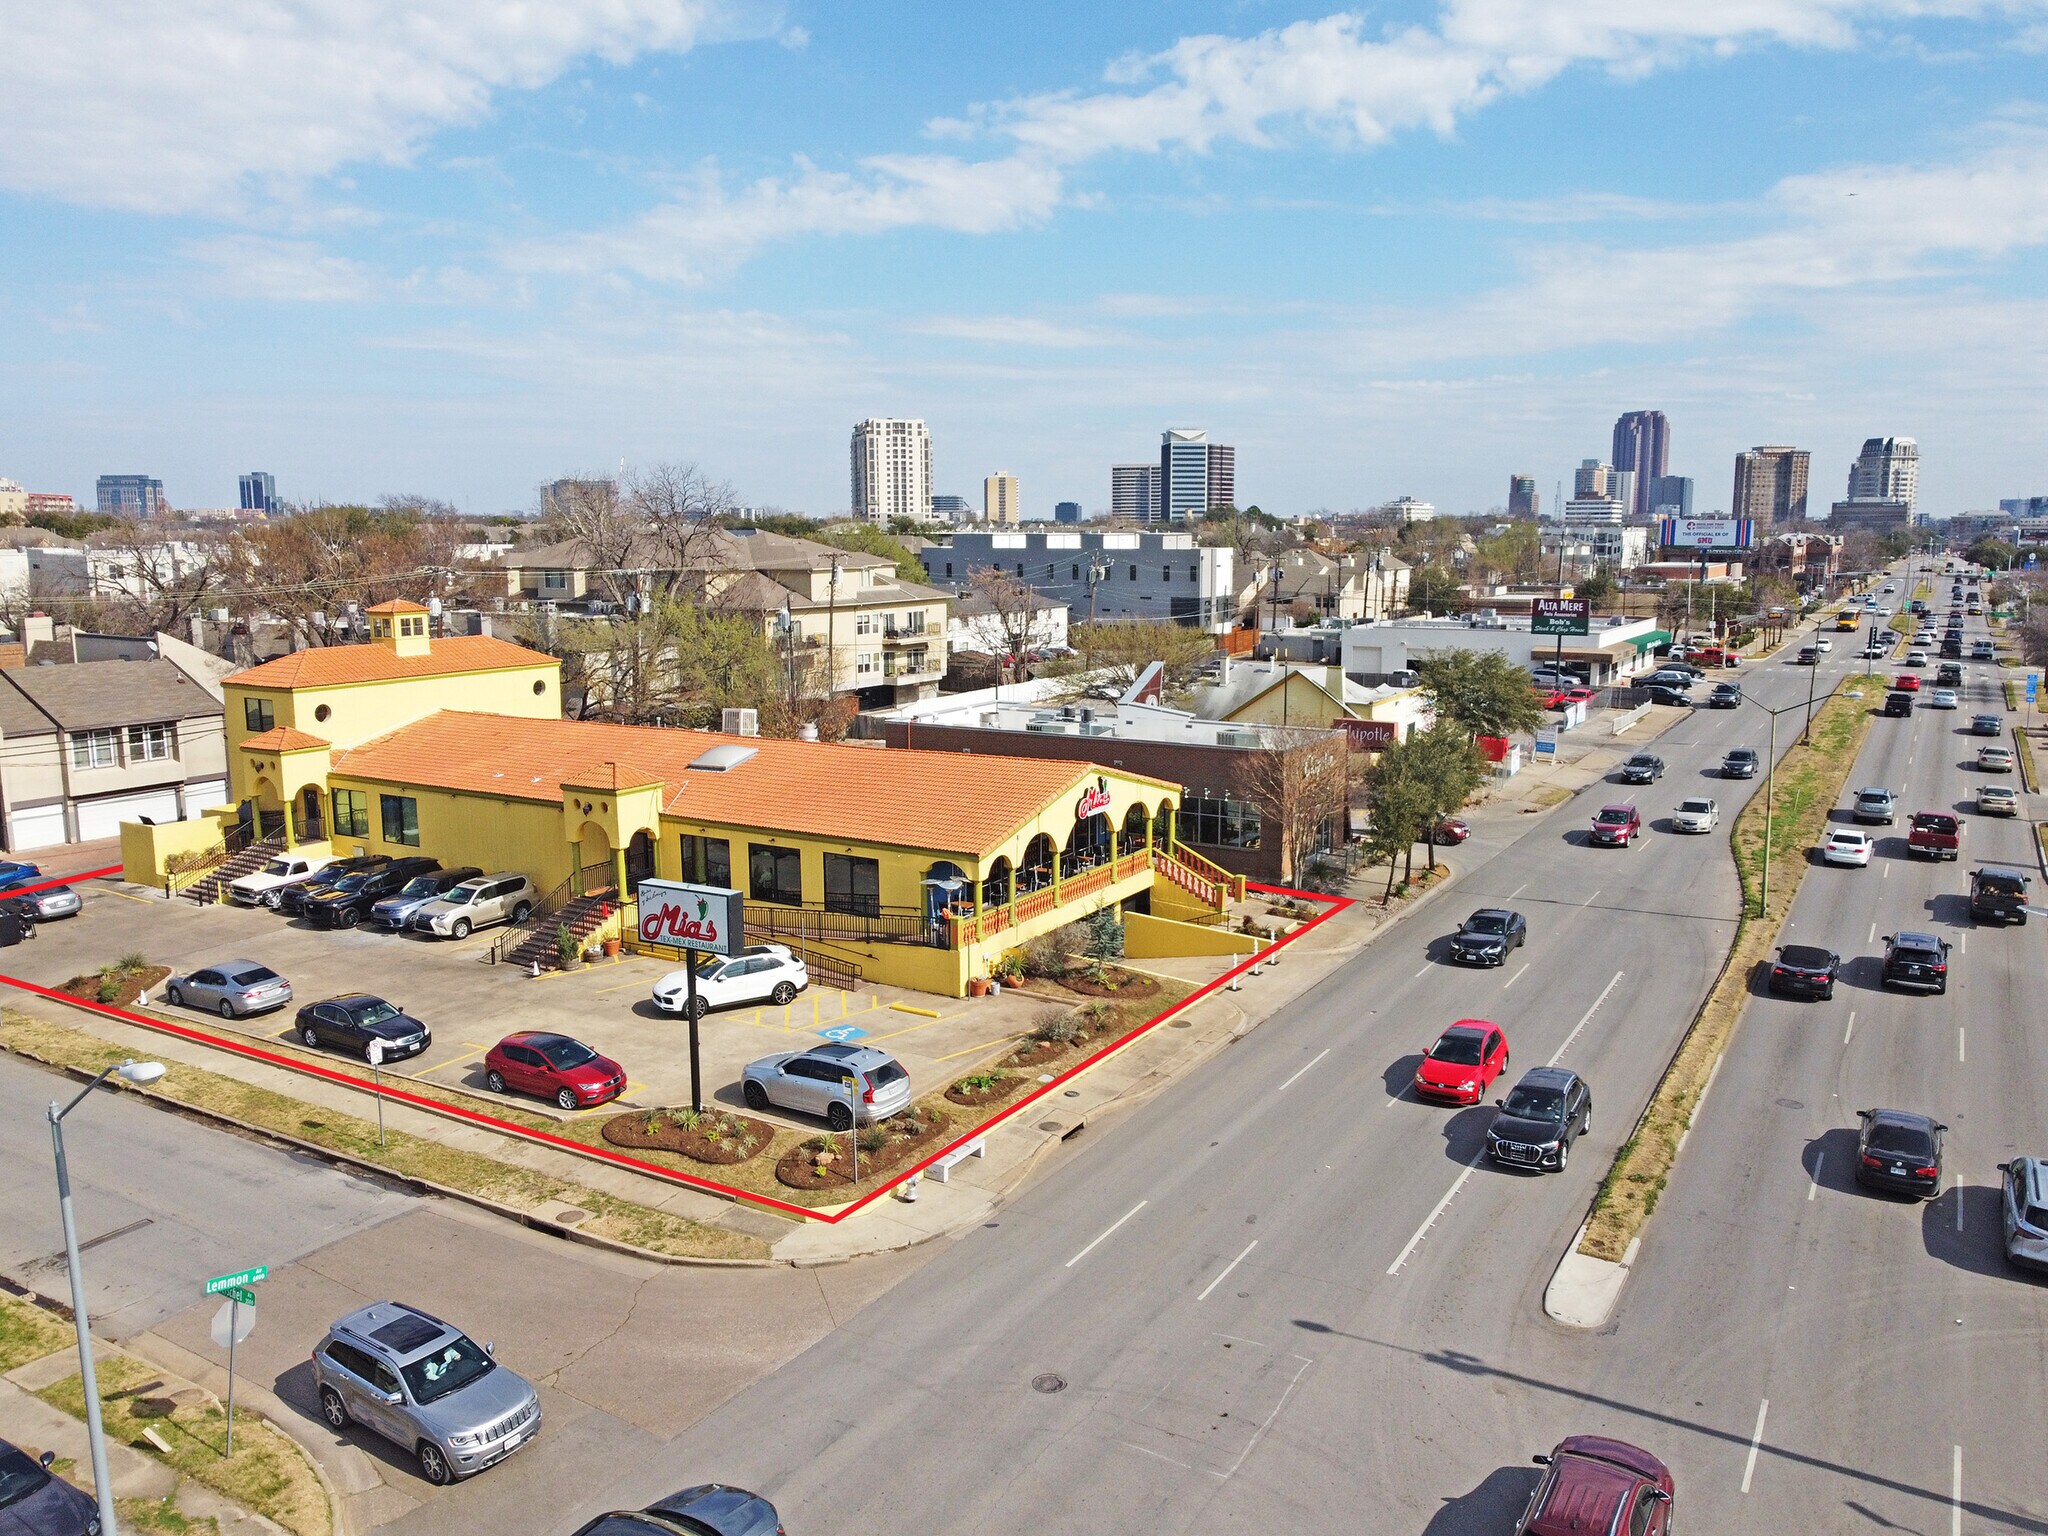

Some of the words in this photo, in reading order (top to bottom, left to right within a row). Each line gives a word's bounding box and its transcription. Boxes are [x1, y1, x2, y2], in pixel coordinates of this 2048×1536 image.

[1538, 599, 1558, 611] ALTA
[1560, 600, 1584, 611] MERE
[660, 934, 687, 945] TEX-MEX
[687, 939, 728, 952] RESTAURANT
[206, 1273, 249, 1293] Lemmon
